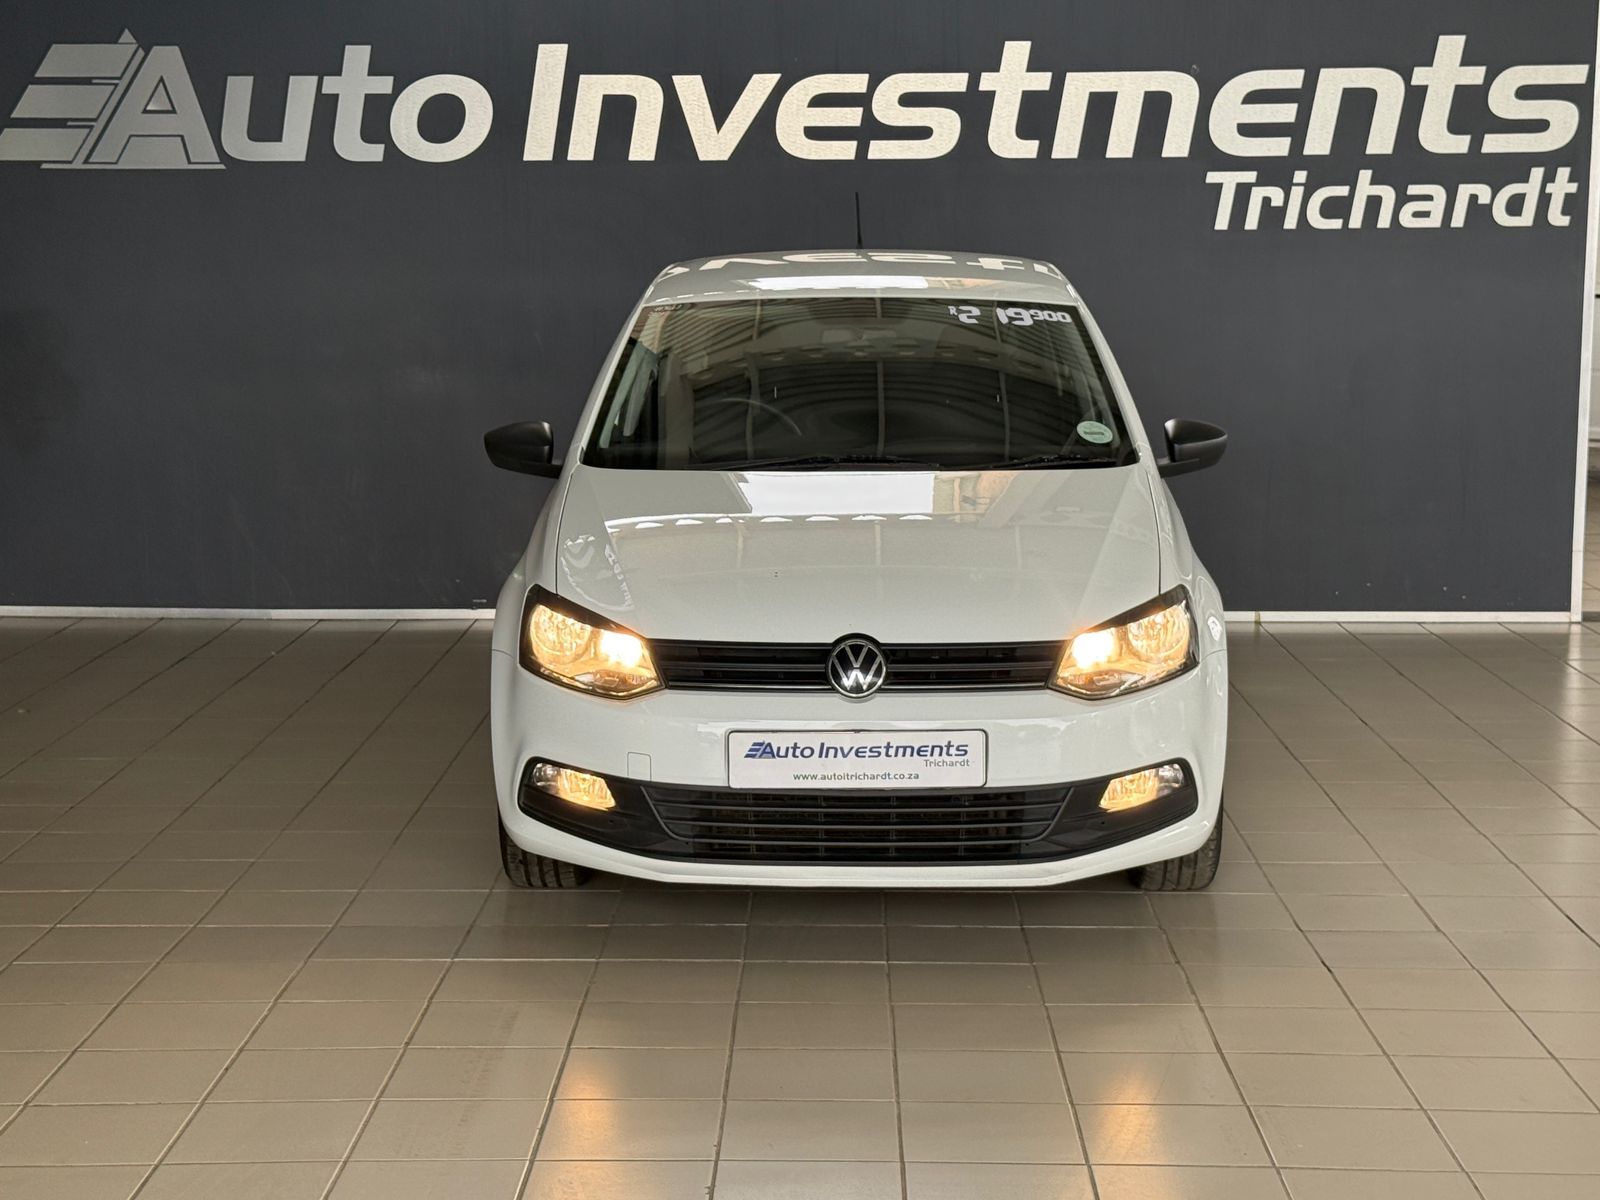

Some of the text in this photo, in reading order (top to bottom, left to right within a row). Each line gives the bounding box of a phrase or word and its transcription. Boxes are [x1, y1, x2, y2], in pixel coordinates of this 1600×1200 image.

[80, 35, 1590, 167] Auto Investments
[1205, 167, 1578, 230] Trichardt
[758, 741, 969, 760] Auto Investments
[924, 759, 970, 768] Trichardt
[793, 771, 920, 781] www.autoitrichardt.co.za
